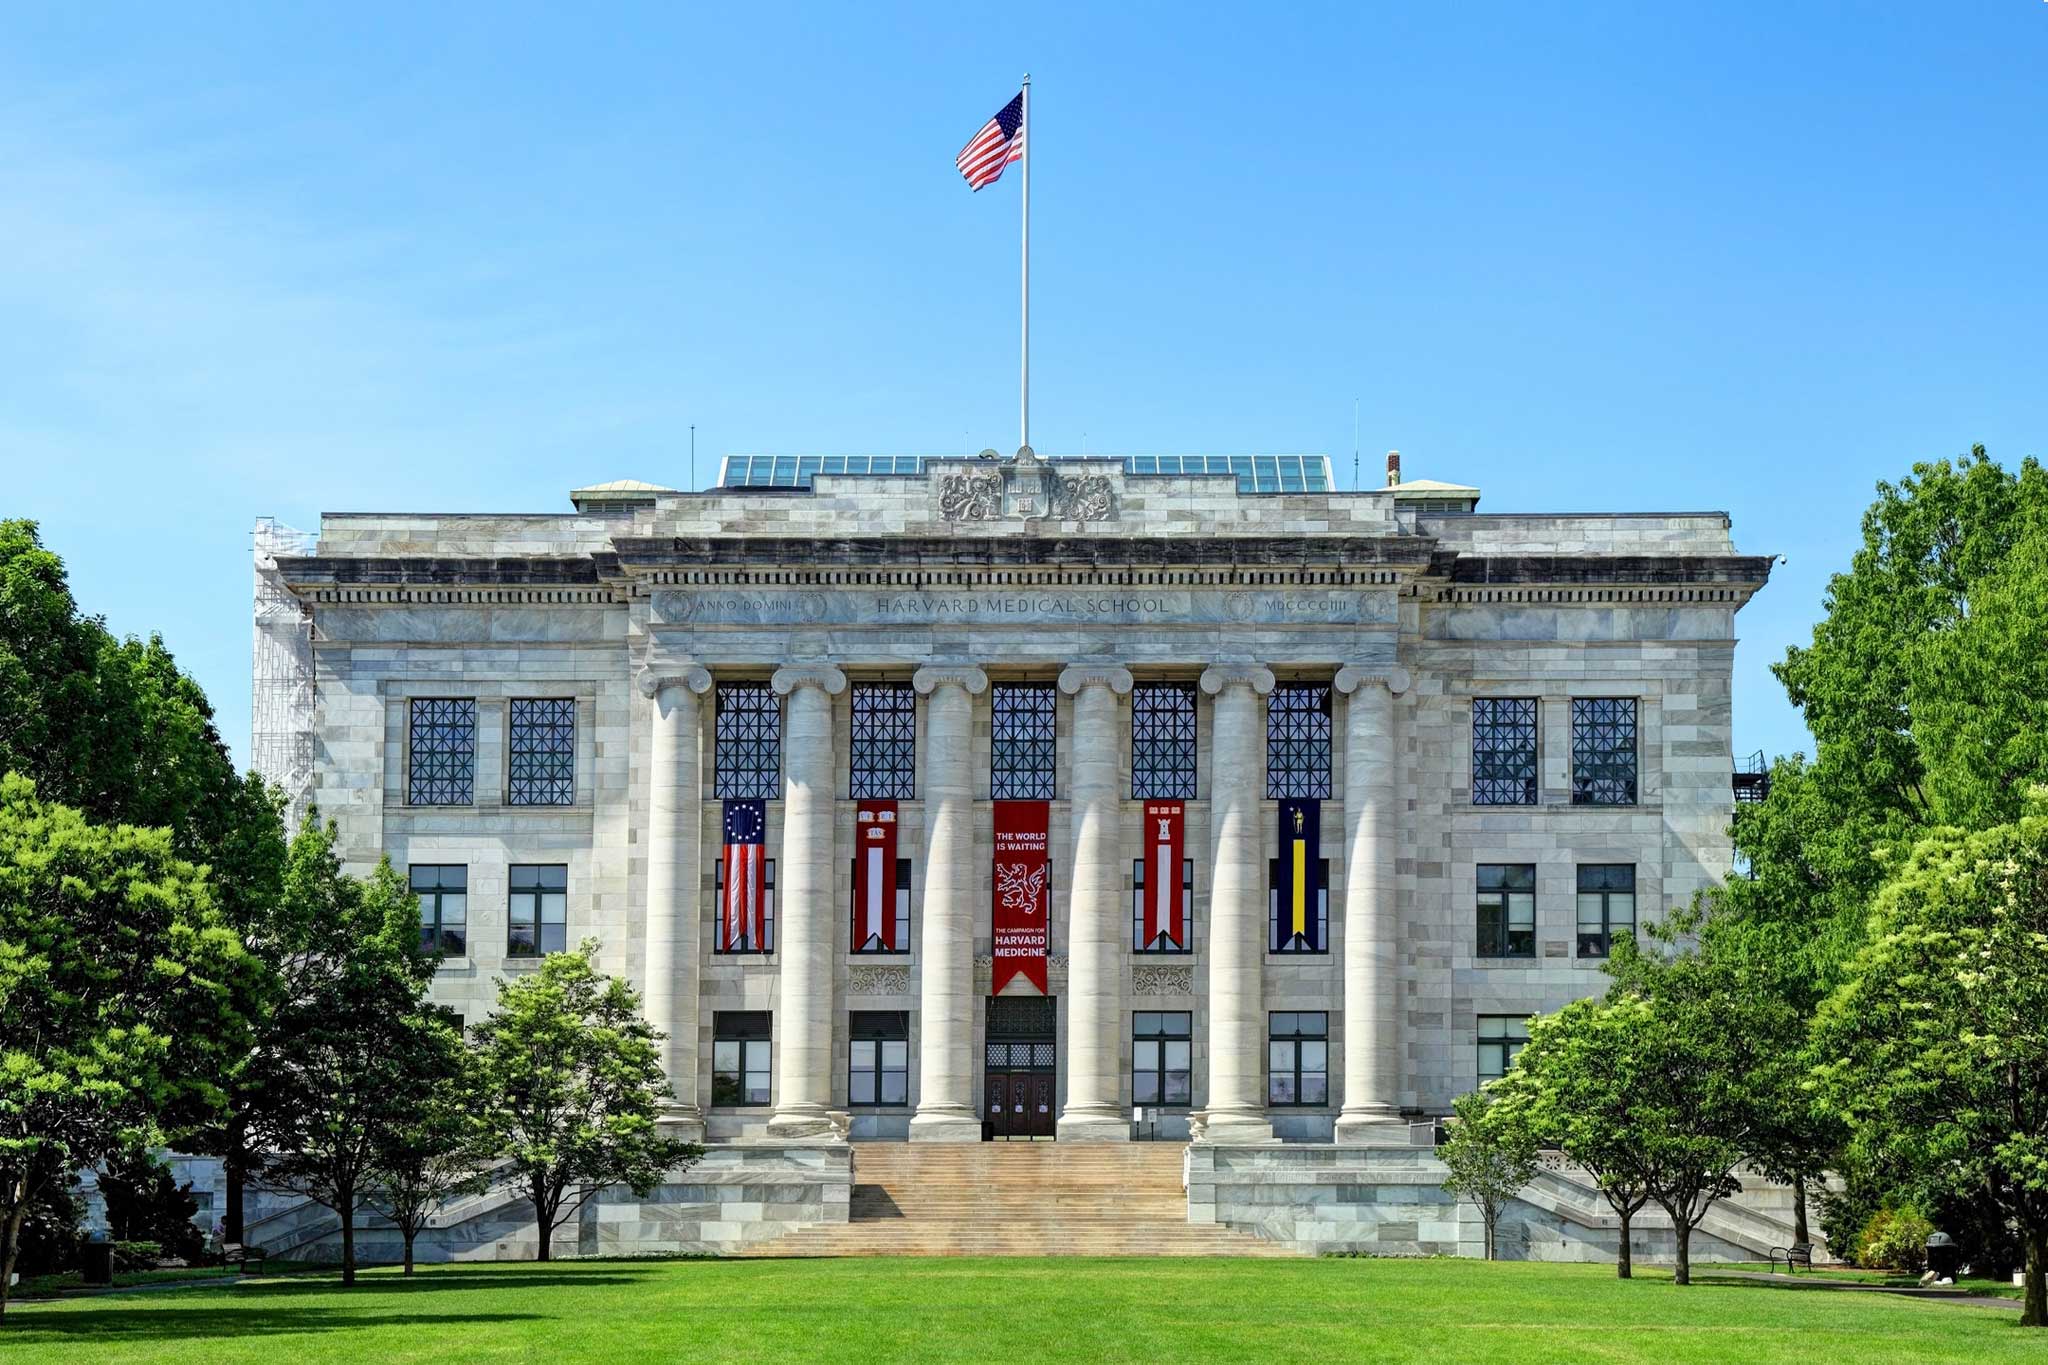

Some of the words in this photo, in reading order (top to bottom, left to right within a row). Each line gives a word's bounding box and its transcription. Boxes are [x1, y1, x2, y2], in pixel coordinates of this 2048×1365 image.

[696, 600, 737, 610] ANNO
[743, 600, 791, 610] DOMINI
[878, 599, 978, 613] HARVARD
[986, 599, 1077, 613] MEDICAL
[1087, 599, 1169, 613] SCHOOL
[1264, 600, 1346, 611] MDCCCCIIII
[996, 832, 1014, 841] THE
[1015, 832, 1047, 841] WORLD
[996, 842, 1006, 851] IS
[1007, 842, 1046, 851] WAITING
[995, 935, 1046, 945] HARVARD
[995, 947, 1046, 957] MEDICINE
